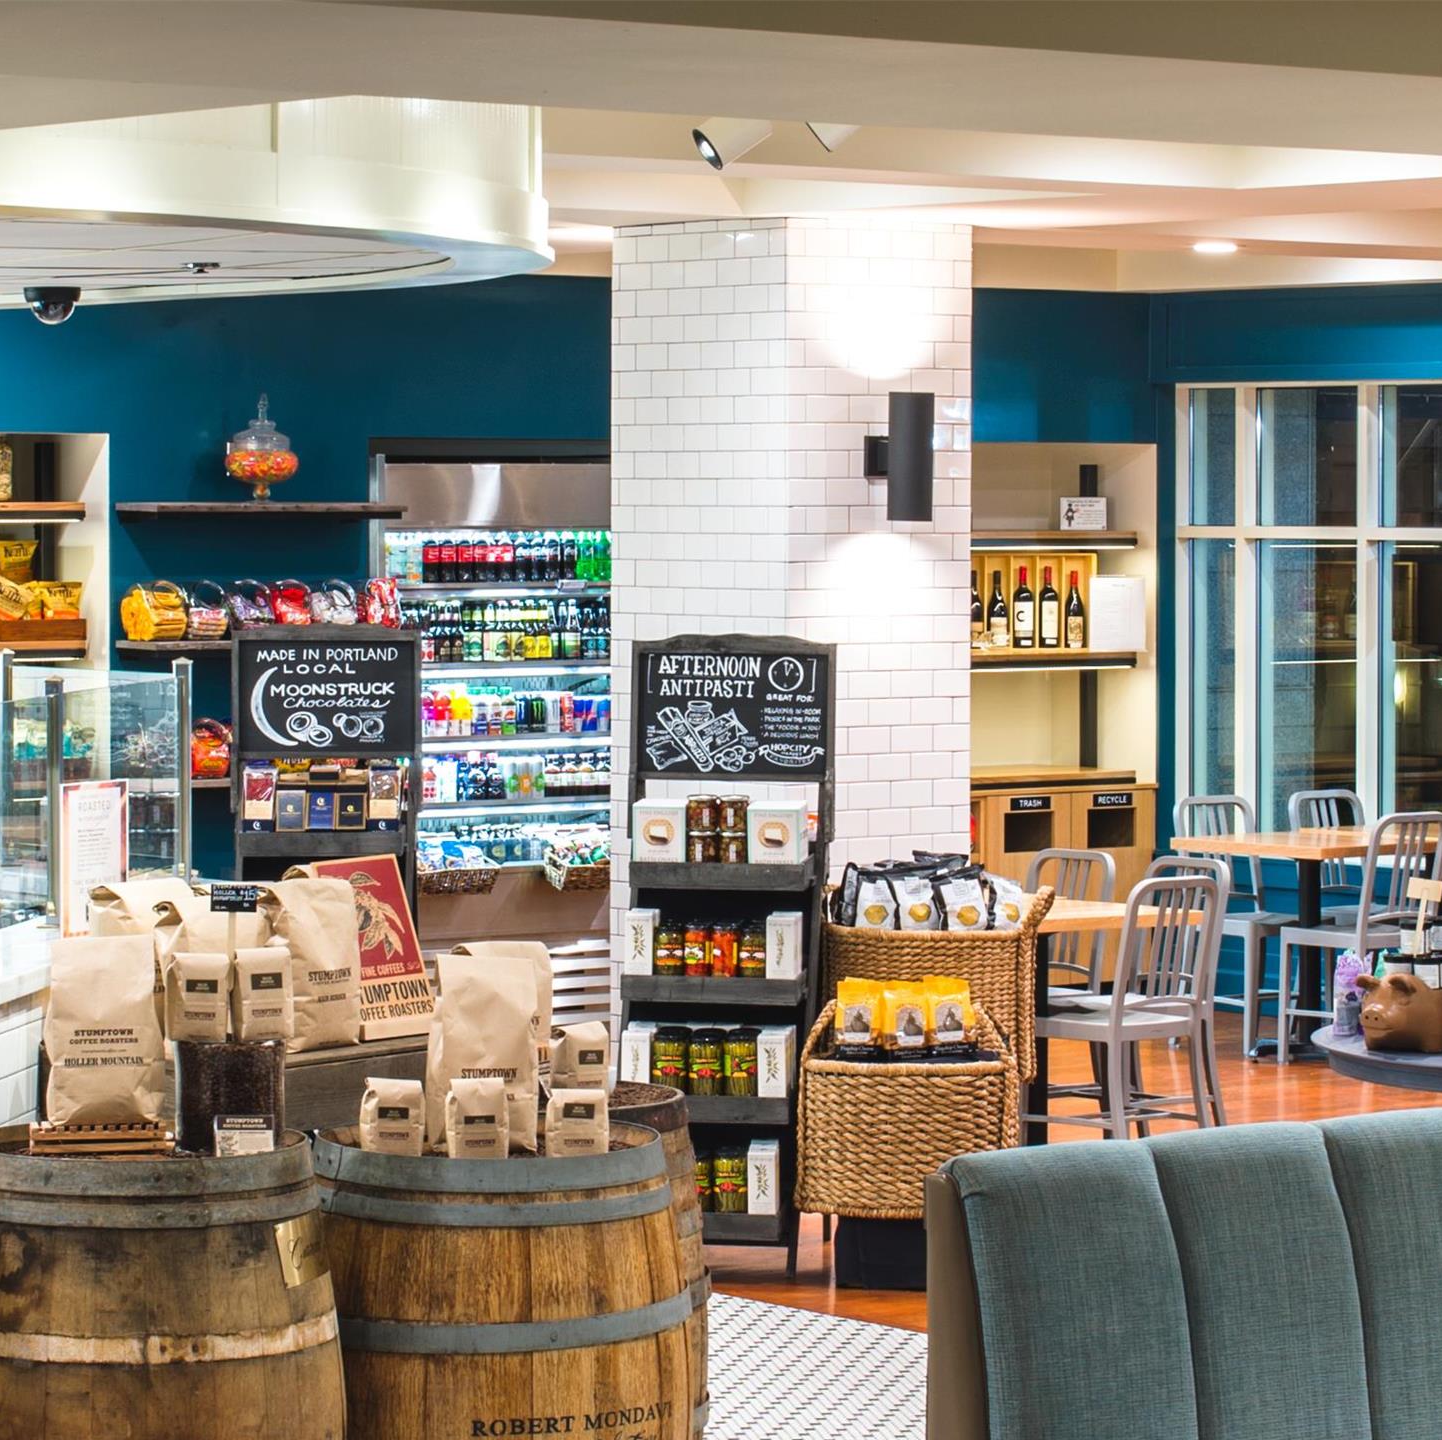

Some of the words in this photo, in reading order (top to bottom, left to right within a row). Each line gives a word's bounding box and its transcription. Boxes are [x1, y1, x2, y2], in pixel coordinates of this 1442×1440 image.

[256, 649, 296, 662] MADE
[303, 649, 320, 661] IN
[326, 647, 399, 661] PORTLAND
[283, 664, 356, 674] LOCAL
[658, 655, 761, 678] AFTERNOON
[270, 682, 396, 697] MOONSTRUCK
[660, 679, 755, 698] ANTIPASTI
[283, 696, 390, 709] Chocolates
[766, 693, 793, 702] GREAT
[1019, 799, 1042, 807] TRASH
[1098, 795, 1127, 804] RECYCLE
[308, 967, 352, 982] STUMPTOWN
[361, 965, 377, 979] FINE
[377, 962, 406, 976] COFFEES
[360, 978, 430, 1005] TUMPTOWN
[360, 1005, 387, 1022] OFFEE
[389, 1000, 434, 1018] ROASTERS
[74, 1028, 134, 1036] STUMPTOWN
[64, 1058, 98, 1067] HOLLER
[99, 1056, 144, 1065] MOUNTAIN
[461, 1068, 518, 1079] STUMPTOWN
[471, 1415, 575, 1437] ROBERT
[584, 1401, 673, 1432] MONDAVI
